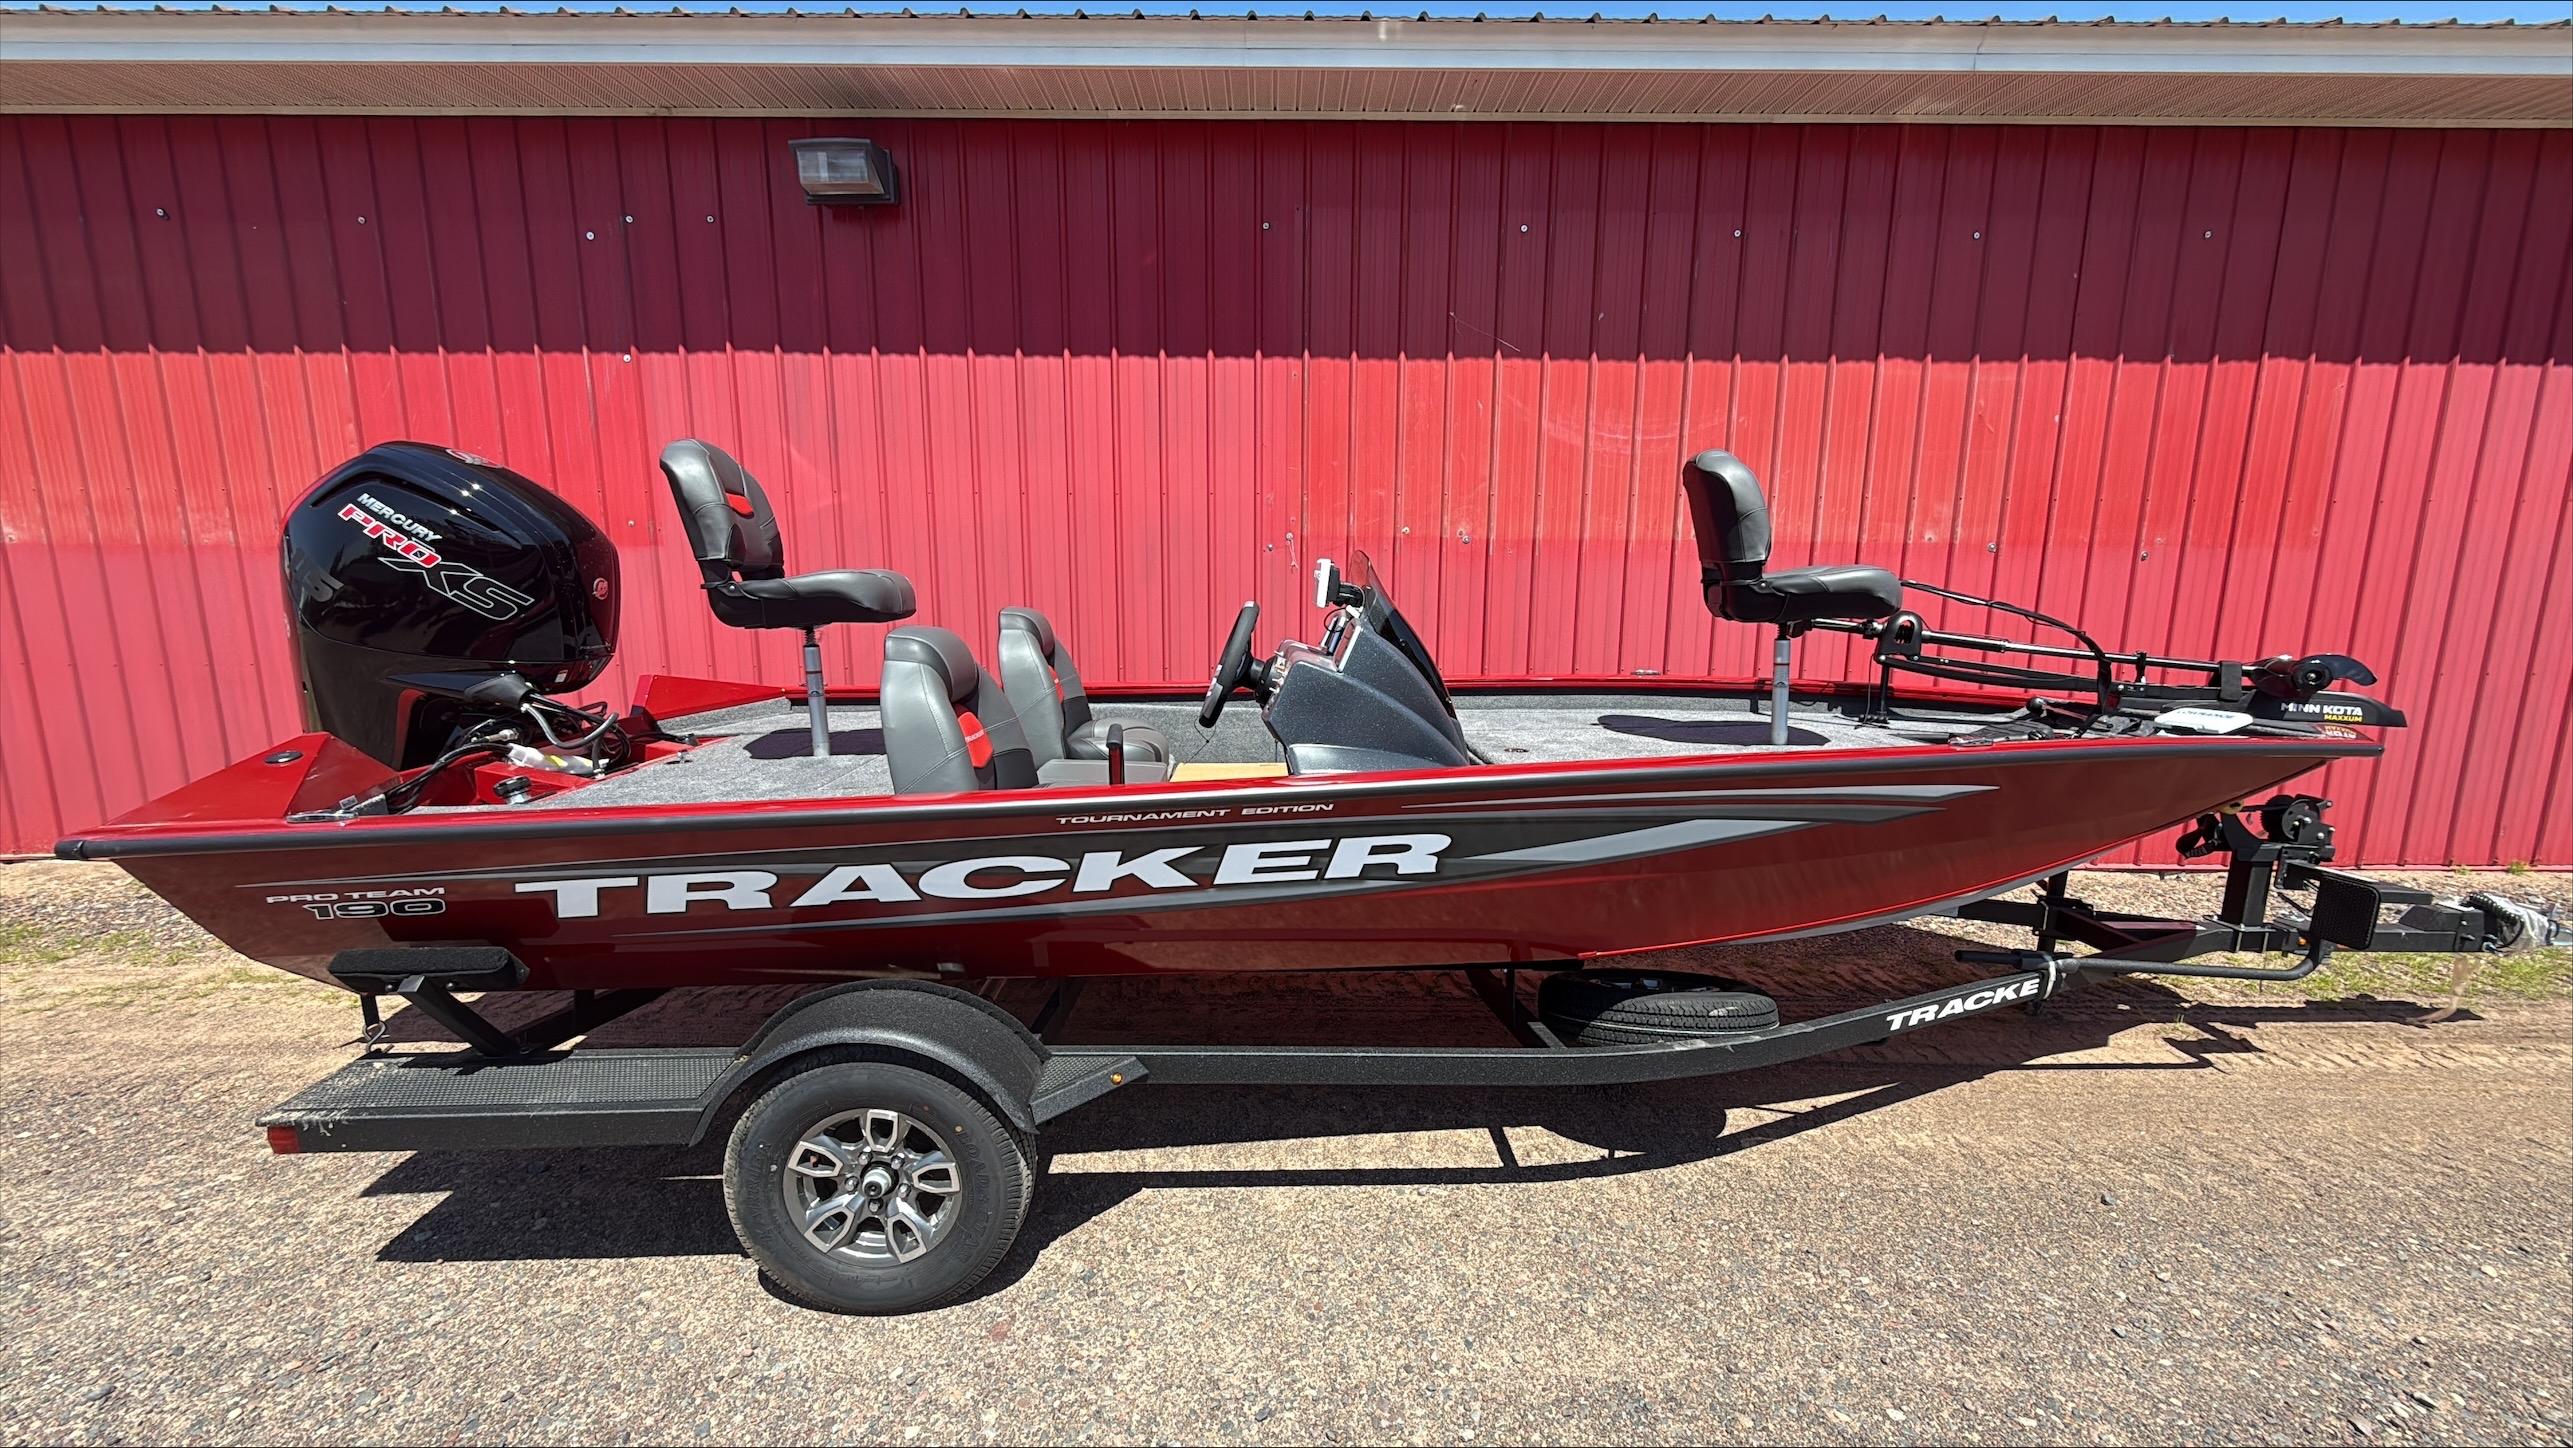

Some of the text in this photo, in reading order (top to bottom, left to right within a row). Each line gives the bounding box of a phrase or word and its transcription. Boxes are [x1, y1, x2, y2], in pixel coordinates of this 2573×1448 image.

[356, 492, 442, 542] MERCURY
[337, 503, 442, 568] PRO
[377, 538, 535, 621] XS
[2280, 702, 2363, 716] MINN KOTA
[2324, 714, 2363, 722] MAXXUM
[1056, 803, 1334, 825] TOURNAMENT EDITION
[515, 834, 1452, 918] TRACKER
[266, 887, 445, 904] PRO TEAM
[302, 898, 446, 920] 190
